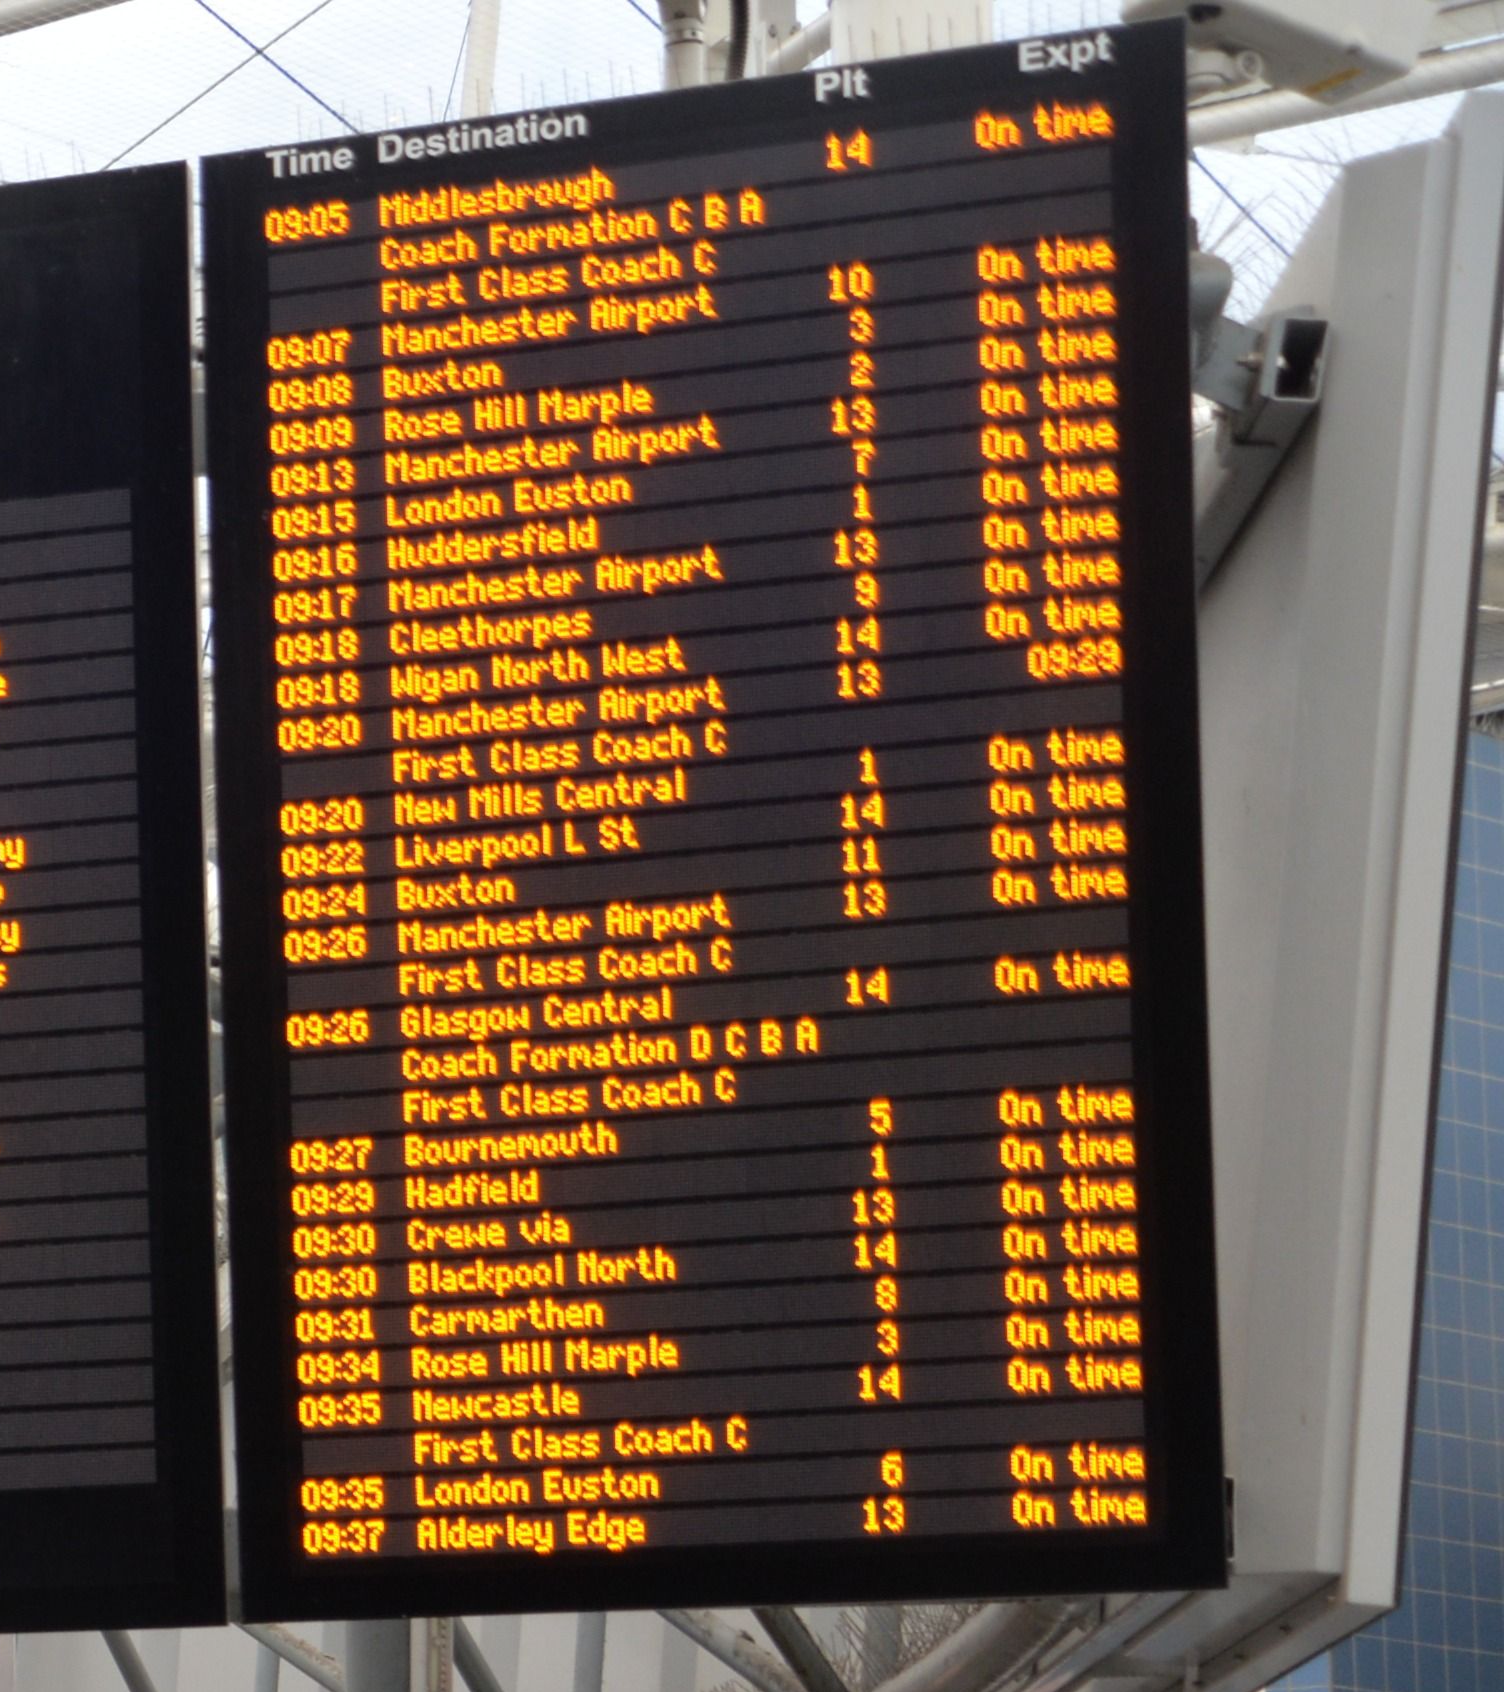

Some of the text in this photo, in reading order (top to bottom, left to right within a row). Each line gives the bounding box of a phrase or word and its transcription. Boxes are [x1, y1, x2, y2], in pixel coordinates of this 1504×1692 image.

[265, 32, 1113, 178] Time Destination Plt Expt
[266, 236, 1116, 373] 09:07 Manchester Airport 10 On time
[301, 1485, 1148, 1557] 09:37 Alderley Edge 13 On time
